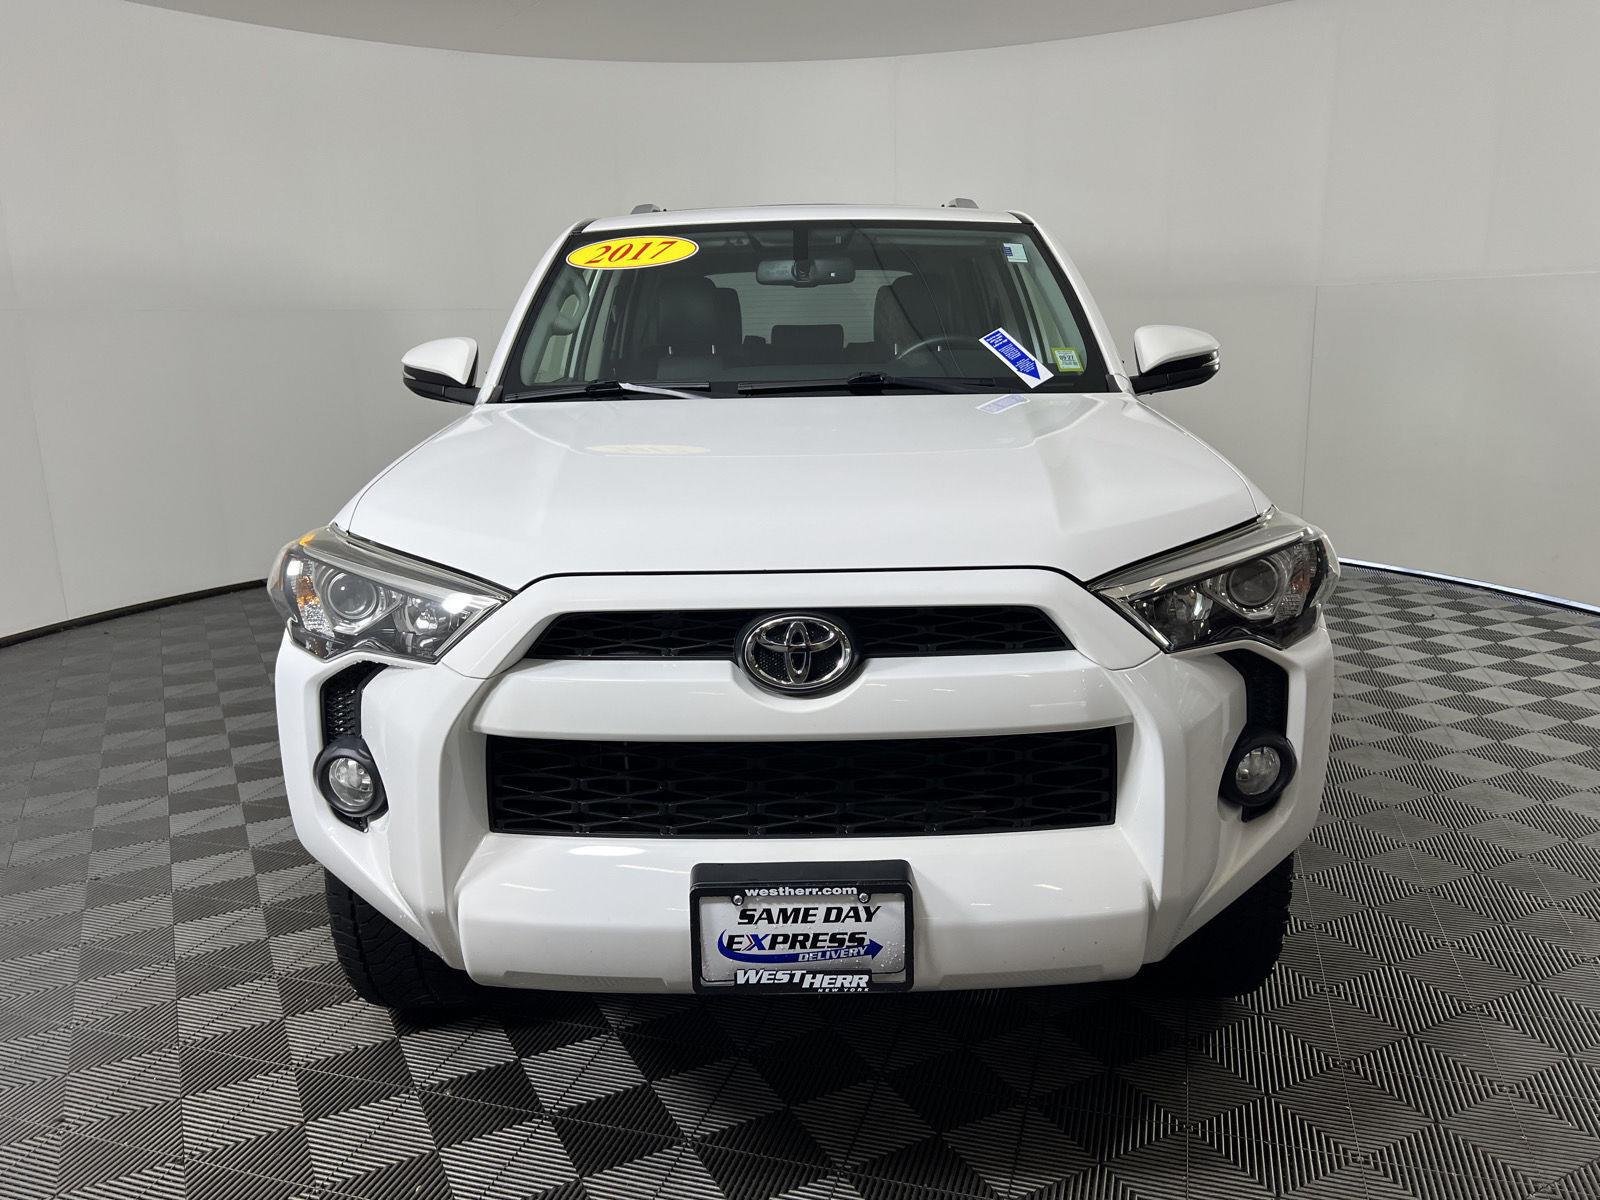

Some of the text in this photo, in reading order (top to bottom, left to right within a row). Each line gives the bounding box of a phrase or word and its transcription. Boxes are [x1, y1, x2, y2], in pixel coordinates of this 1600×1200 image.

[584, 240, 678, 264] 2017
[745, 887, 857, 896] westherr.com
[738, 906, 882, 925] SAME DAY
[726, 932, 867, 950] EXPRESS
[798, 946, 867, 962] DELIVERY
